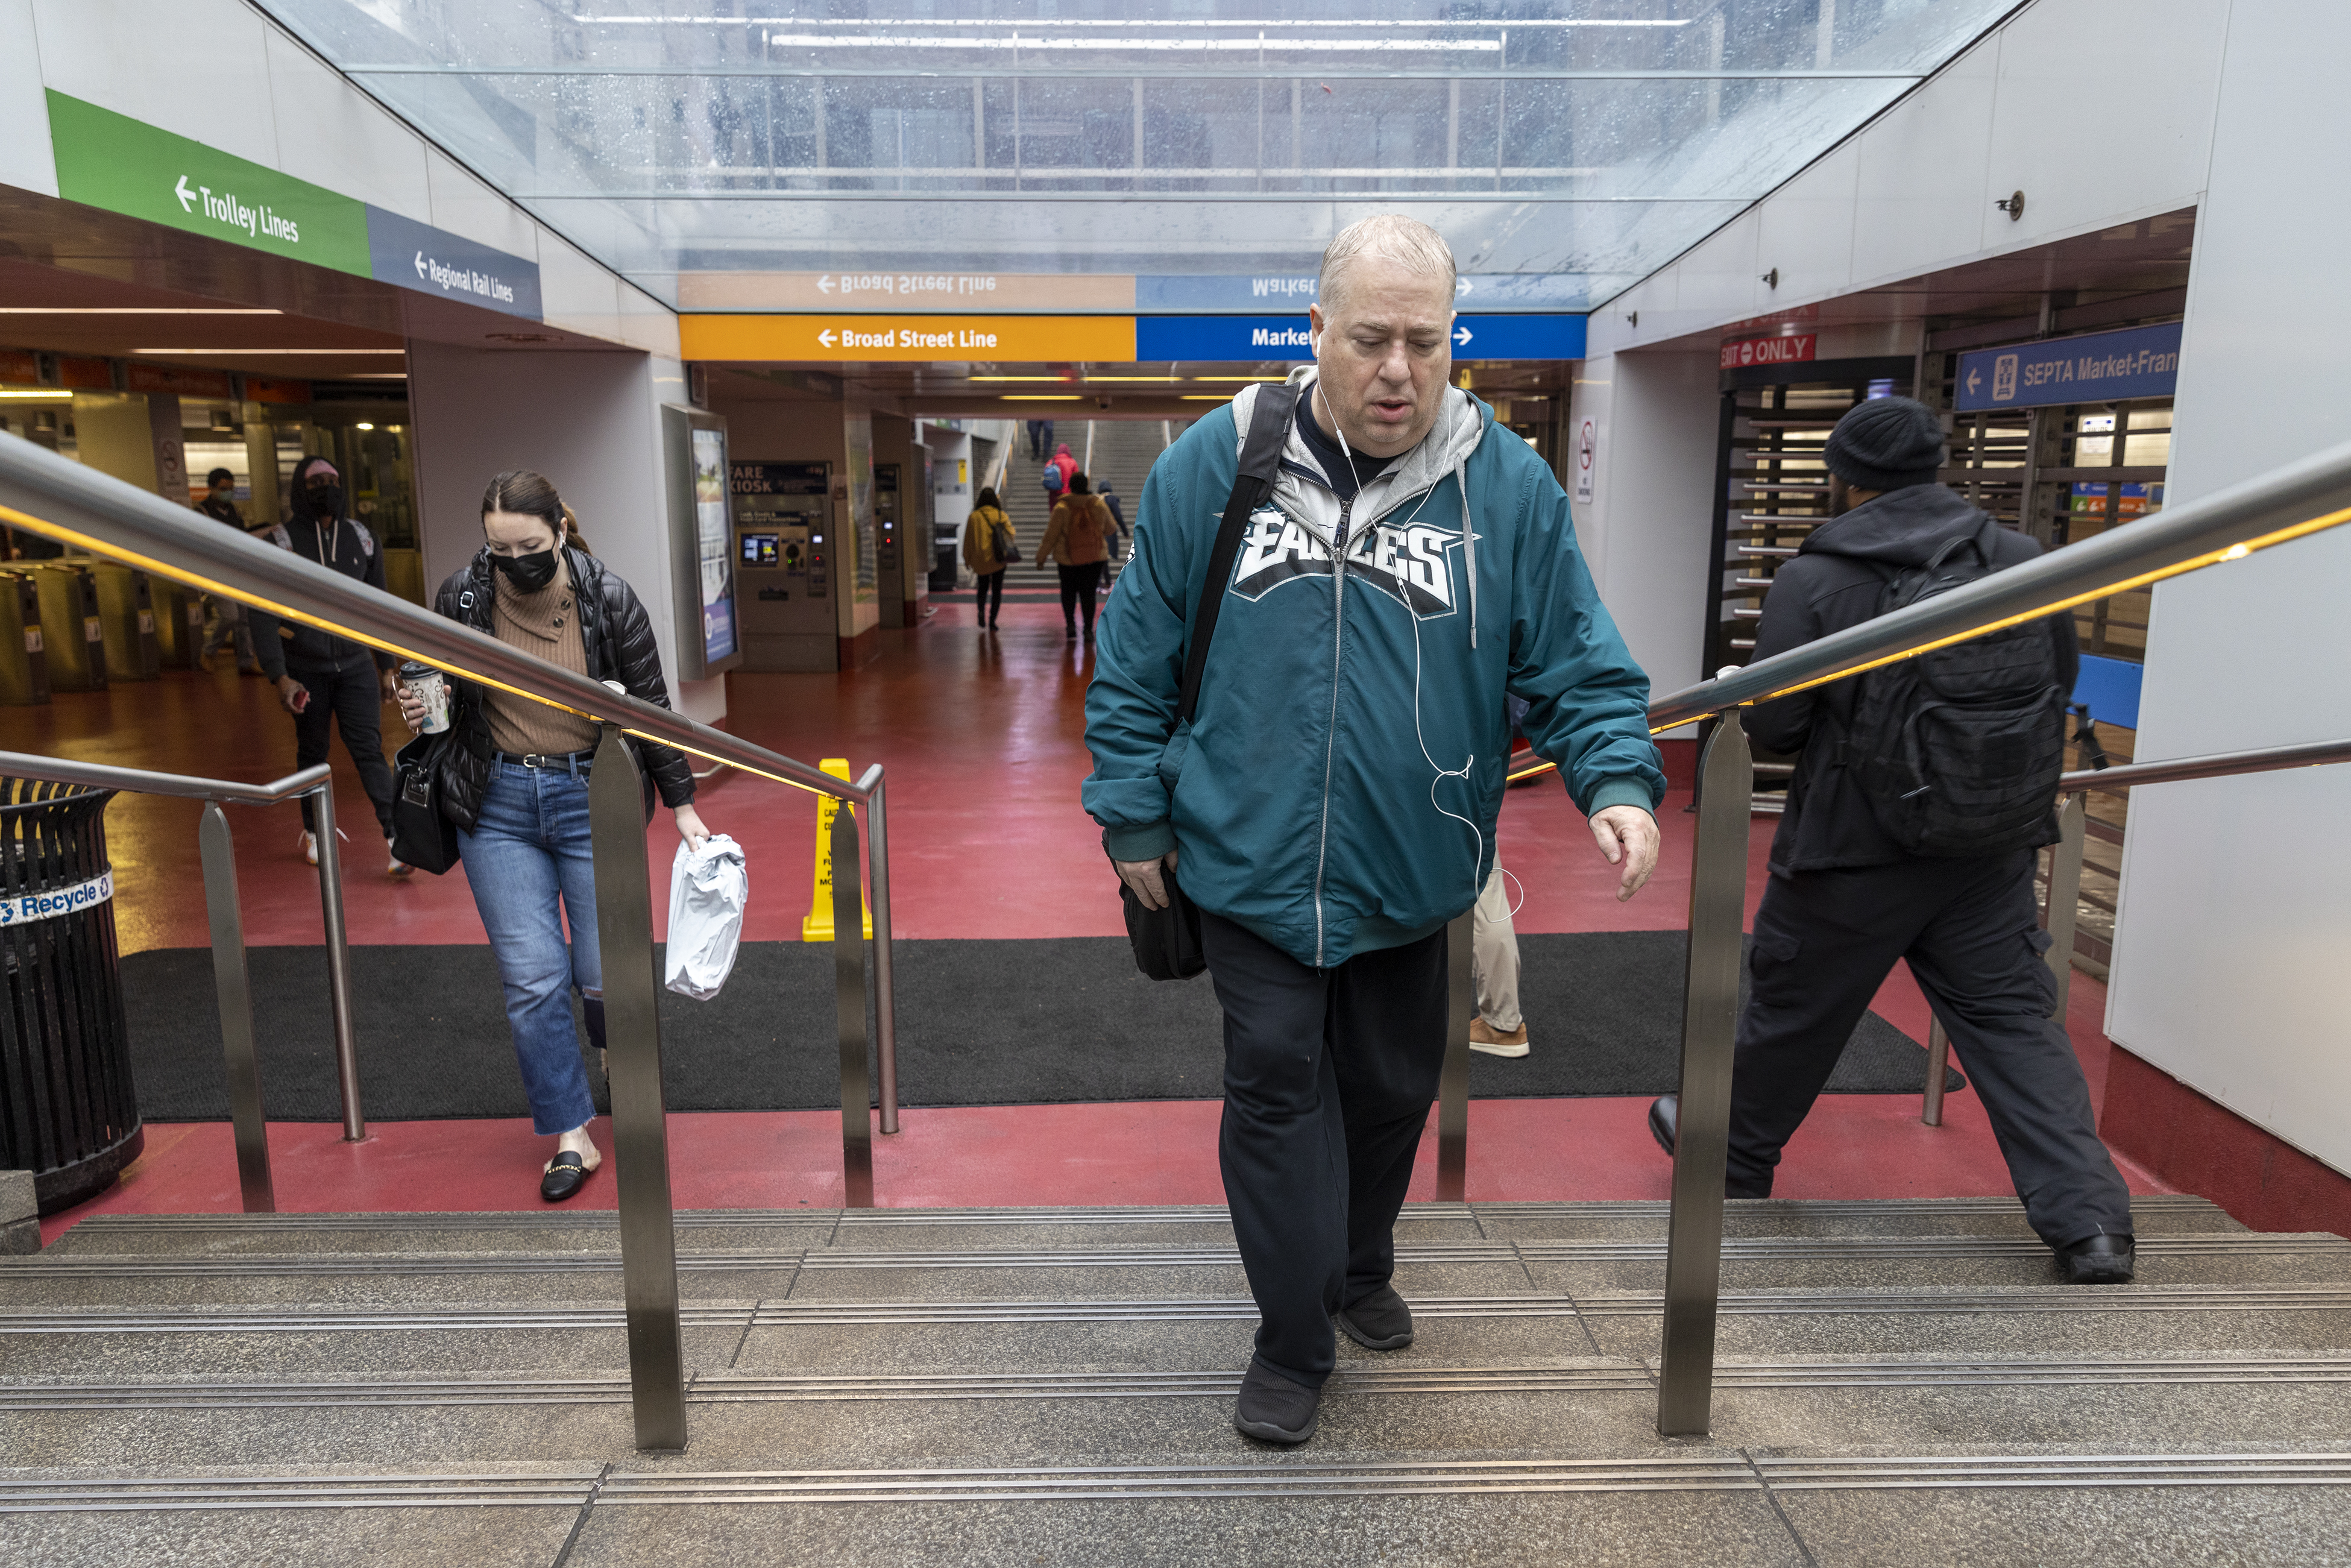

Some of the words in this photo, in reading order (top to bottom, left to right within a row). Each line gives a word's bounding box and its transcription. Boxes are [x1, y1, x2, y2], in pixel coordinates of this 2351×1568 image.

[200, 186, 256, 238] Trolley
[259, 205, 299, 243] Lines
[429, 257, 471, 291] Regional
[472, 271, 491, 297] Rail
[491, 276, 514, 303] Lines
[842, 329, 895, 347] Broad
[899, 329, 955, 347] Street
[960, 329, 998, 347] Line
[1721, 345, 1739, 367] EXIT
[1755, 338, 1807, 362] ONLY
[2024, 360, 2073, 386] SEPTA
[21, 884, 96, 916] Recycle
